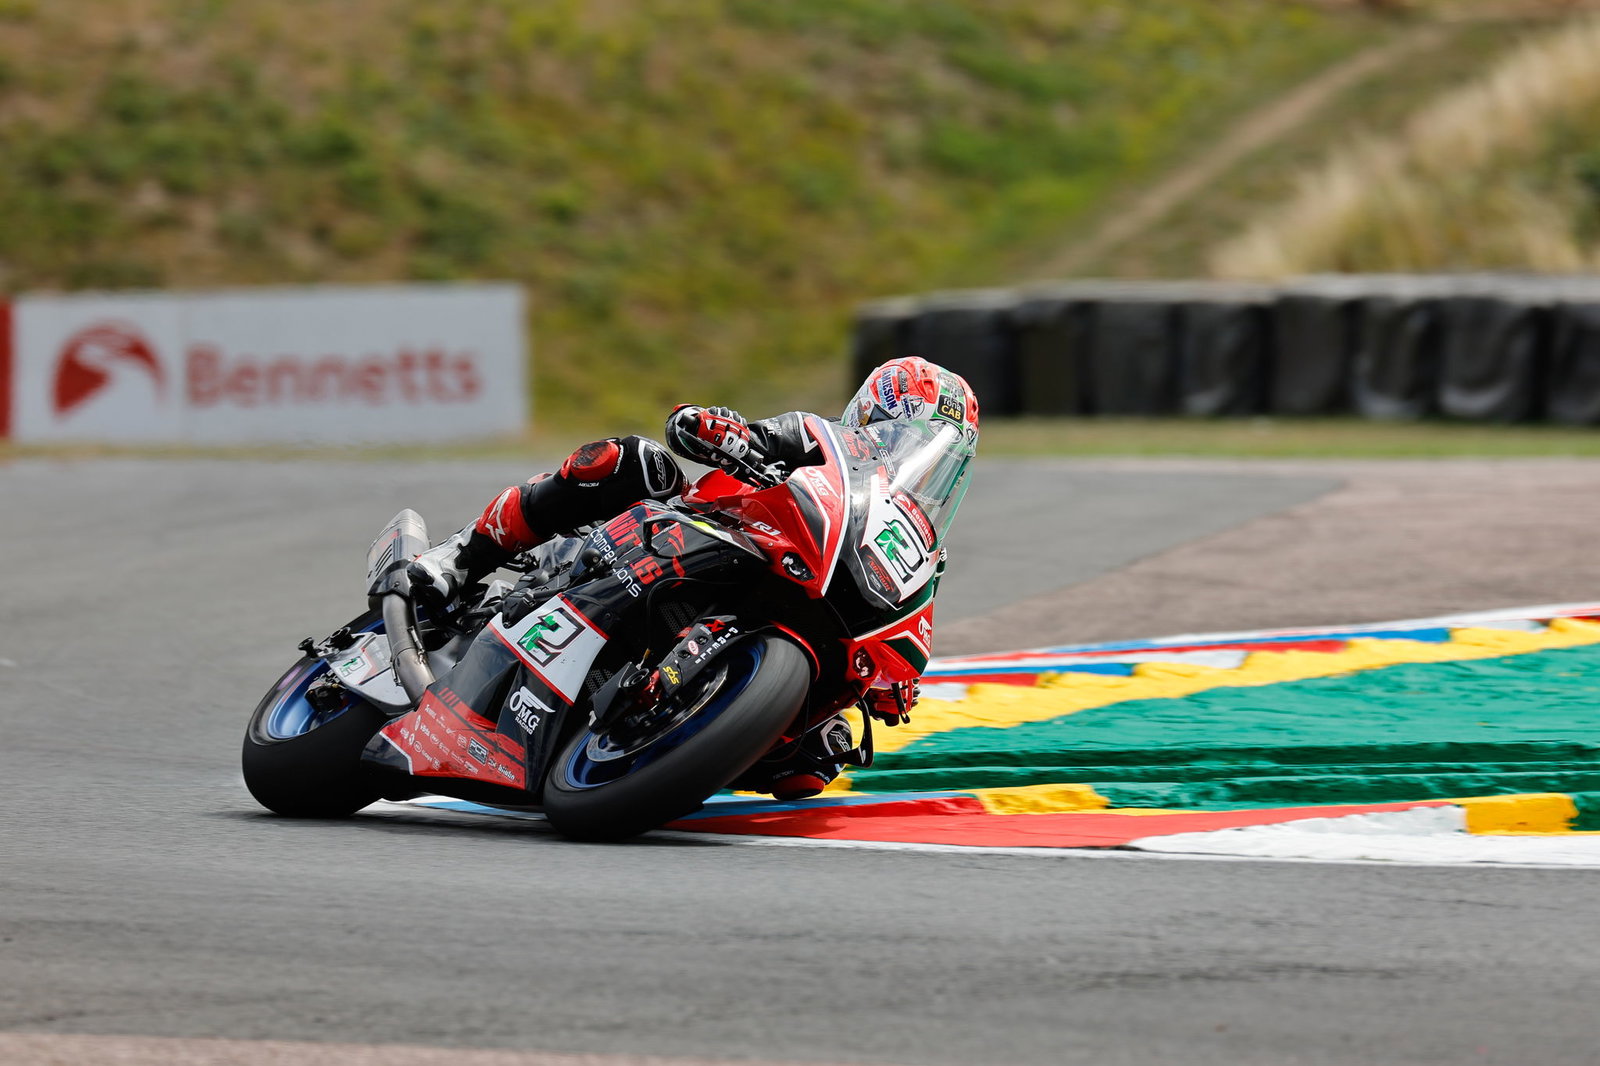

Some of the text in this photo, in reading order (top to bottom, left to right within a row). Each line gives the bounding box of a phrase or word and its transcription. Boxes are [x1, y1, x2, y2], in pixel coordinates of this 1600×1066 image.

[184, 343, 482, 406] Bennetts
[941, 406, 962, 420] CAB
[752, 521, 782, 535] R1
[911, 508, 935, 546] Bennetts
[590, 529, 642, 598] competions
[874, 519, 925, 584] 2
[516, 606, 586, 668] 2
[509, 687, 545, 730] OMG
[515, 715, 534, 736] RACING
